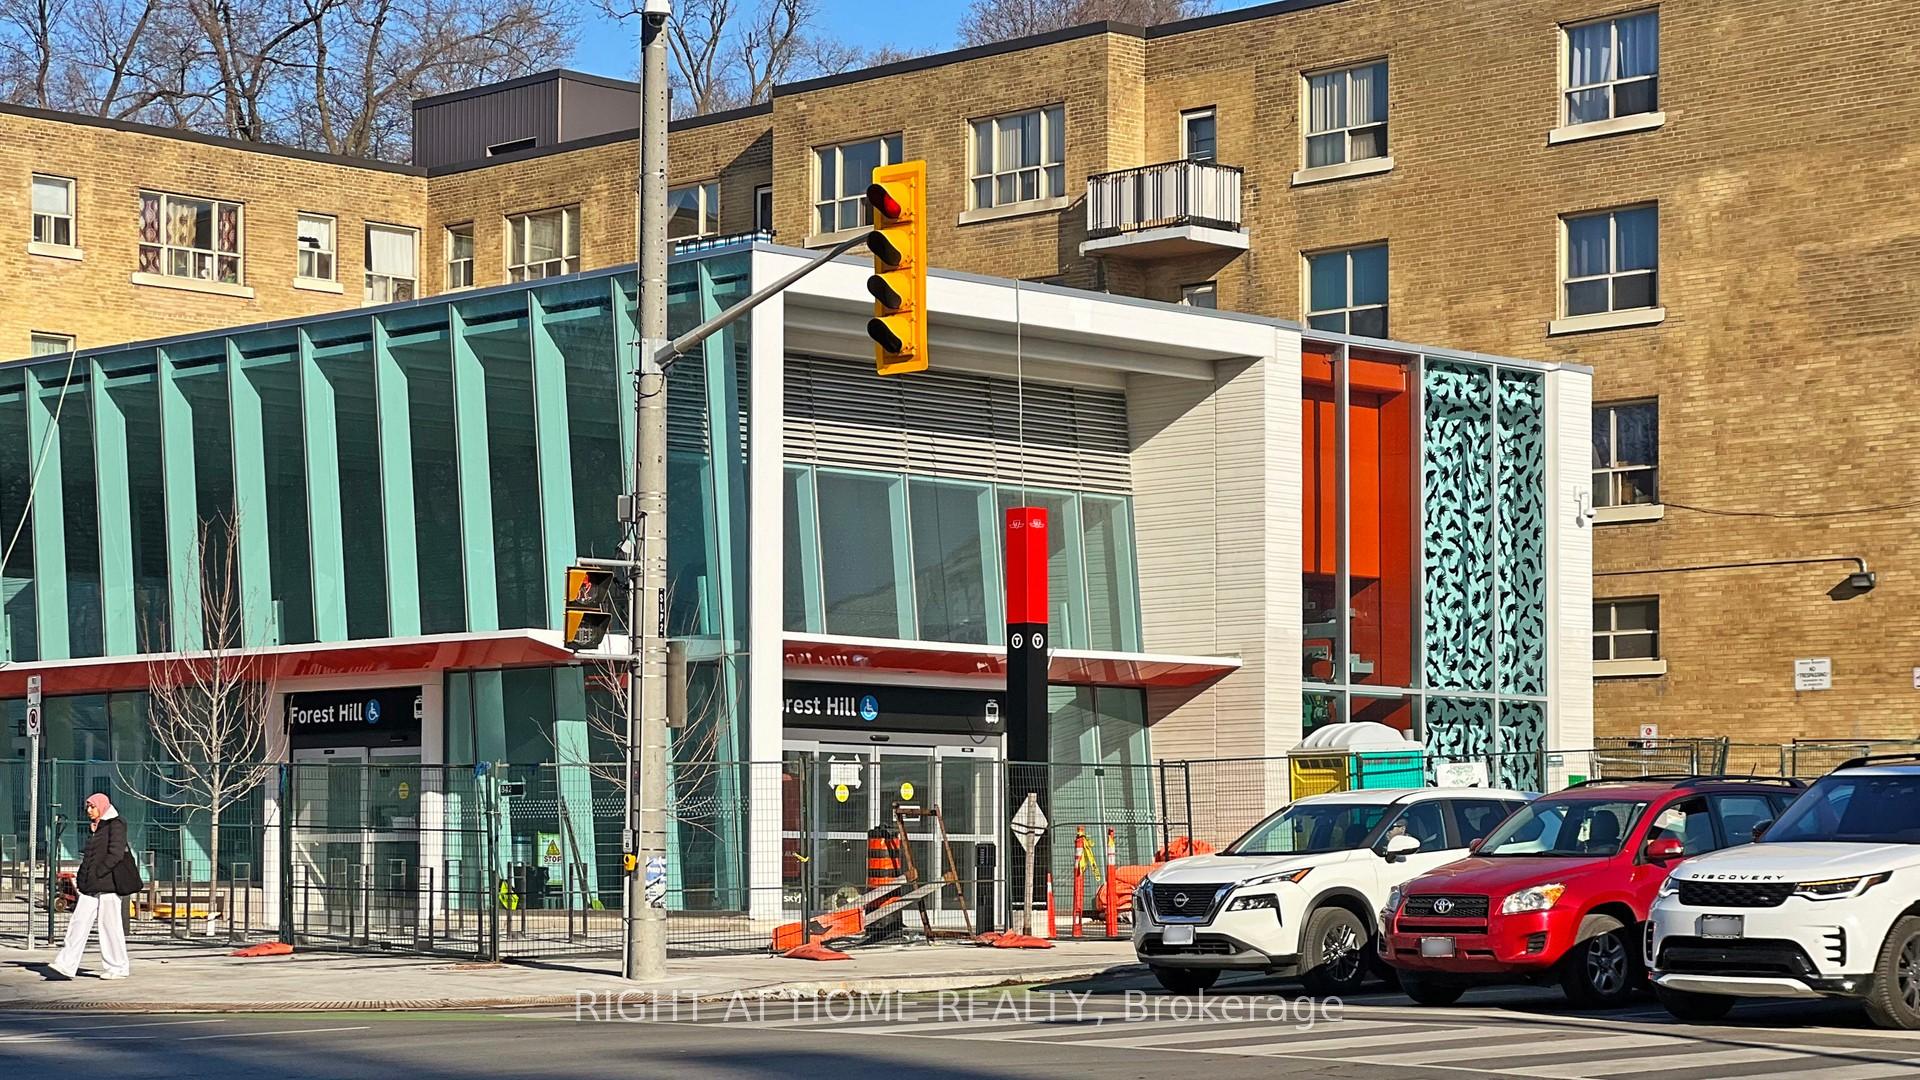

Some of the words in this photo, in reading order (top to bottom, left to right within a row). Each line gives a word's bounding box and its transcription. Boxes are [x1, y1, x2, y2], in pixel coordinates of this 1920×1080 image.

[291, 705, 335, 724] Forest
[339, 702, 363, 722] Hill
[826, 696, 858, 717] Hill
[1691, 873, 1785, 881] DISCOVERY
